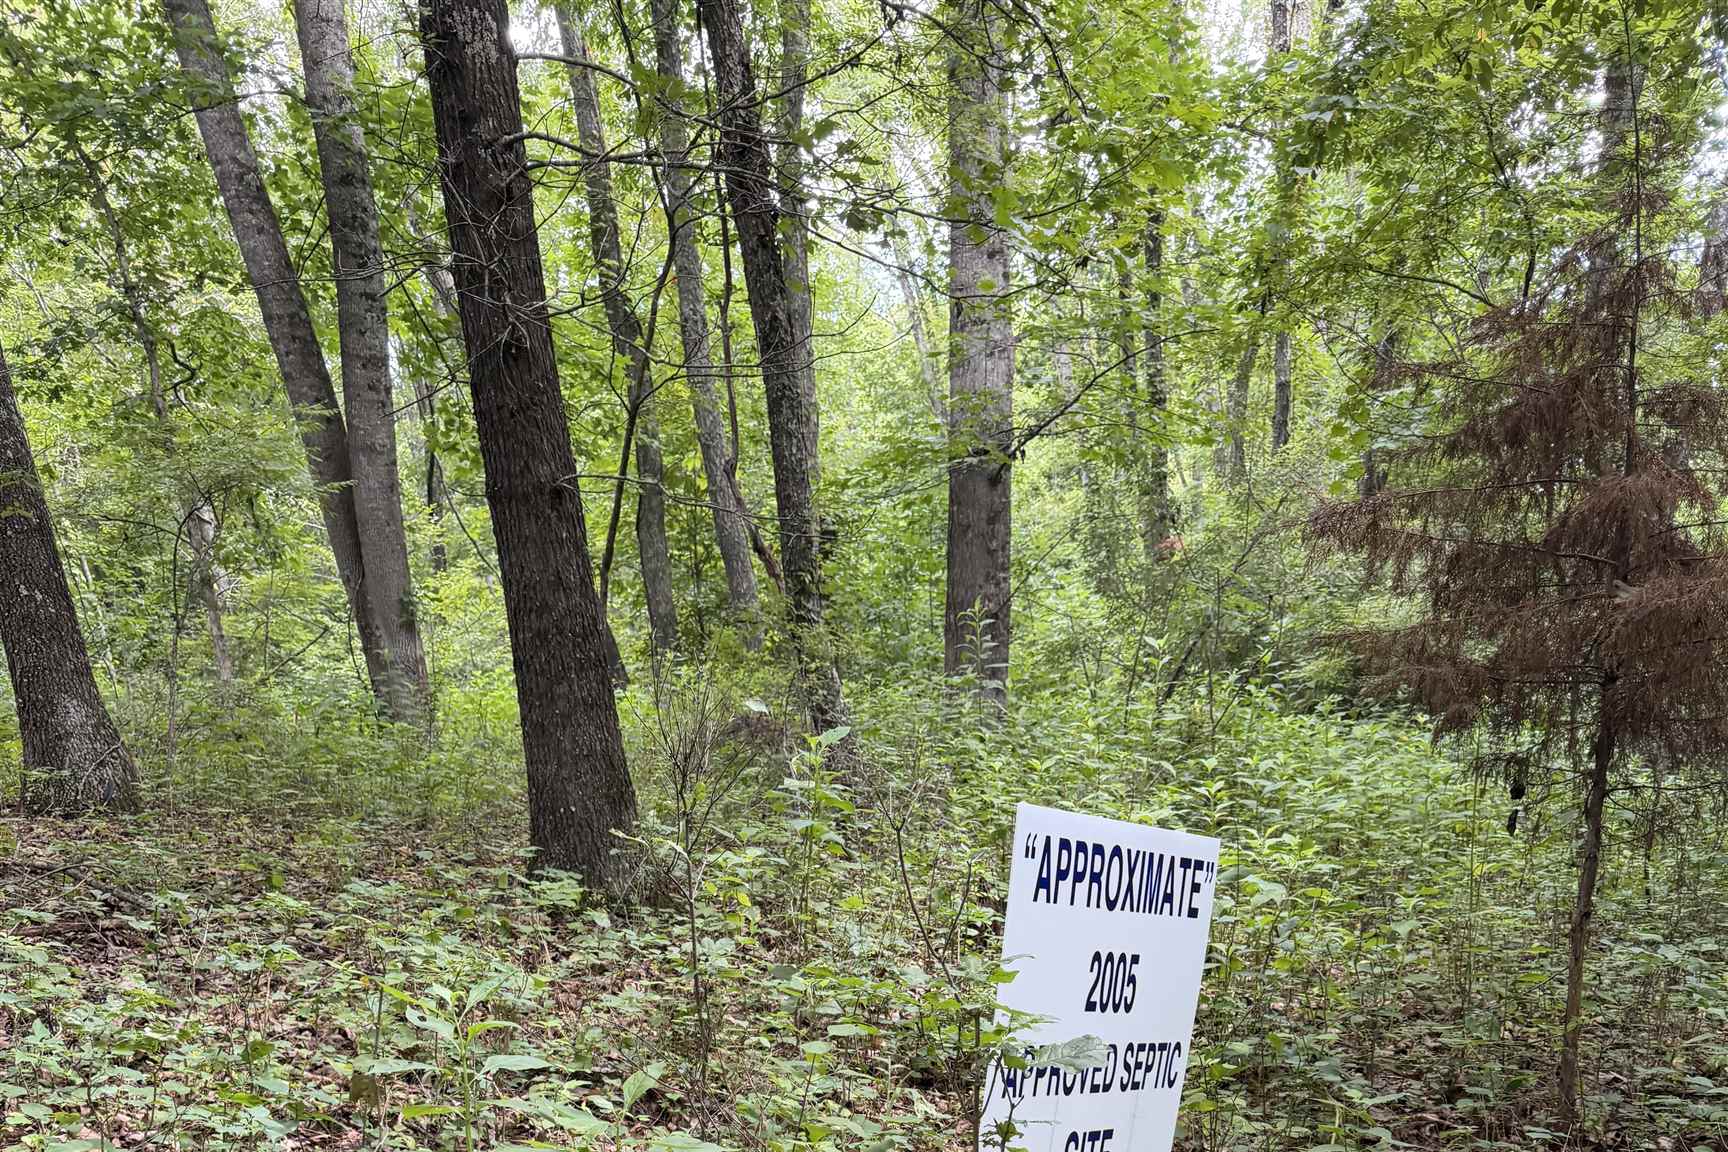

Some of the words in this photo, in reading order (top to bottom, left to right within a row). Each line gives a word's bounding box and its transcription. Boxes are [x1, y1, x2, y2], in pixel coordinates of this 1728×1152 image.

[1024, 832, 1215, 919] “APPROXIMATE”
[1084, 950, 1140, 1014] 2005
[1120, 1041, 1182, 1092] SEPTIC
